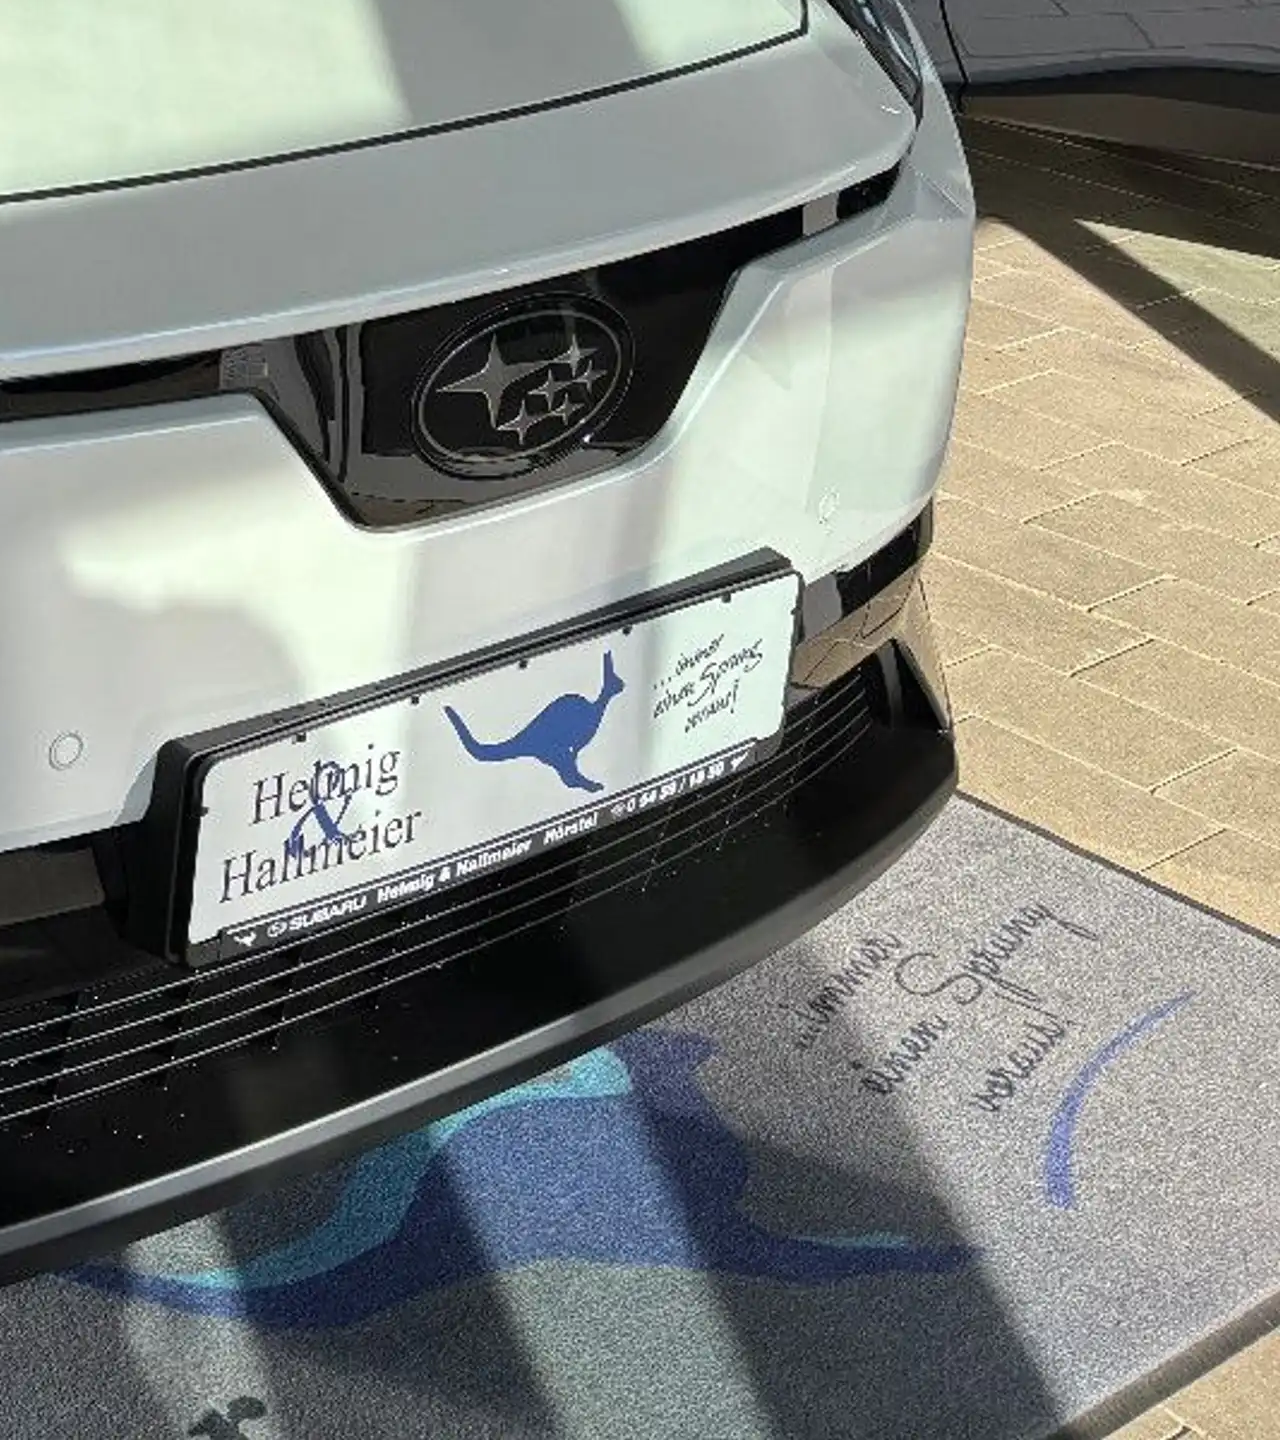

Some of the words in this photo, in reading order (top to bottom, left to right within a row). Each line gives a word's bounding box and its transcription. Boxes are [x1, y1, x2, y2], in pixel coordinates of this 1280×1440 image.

[248, 743, 401, 826] Helmig
[219, 809, 422, 904] Hallmeier
[289, 895, 367, 931] SUBARU
[893, 902, 1101, 1007] Sprung
